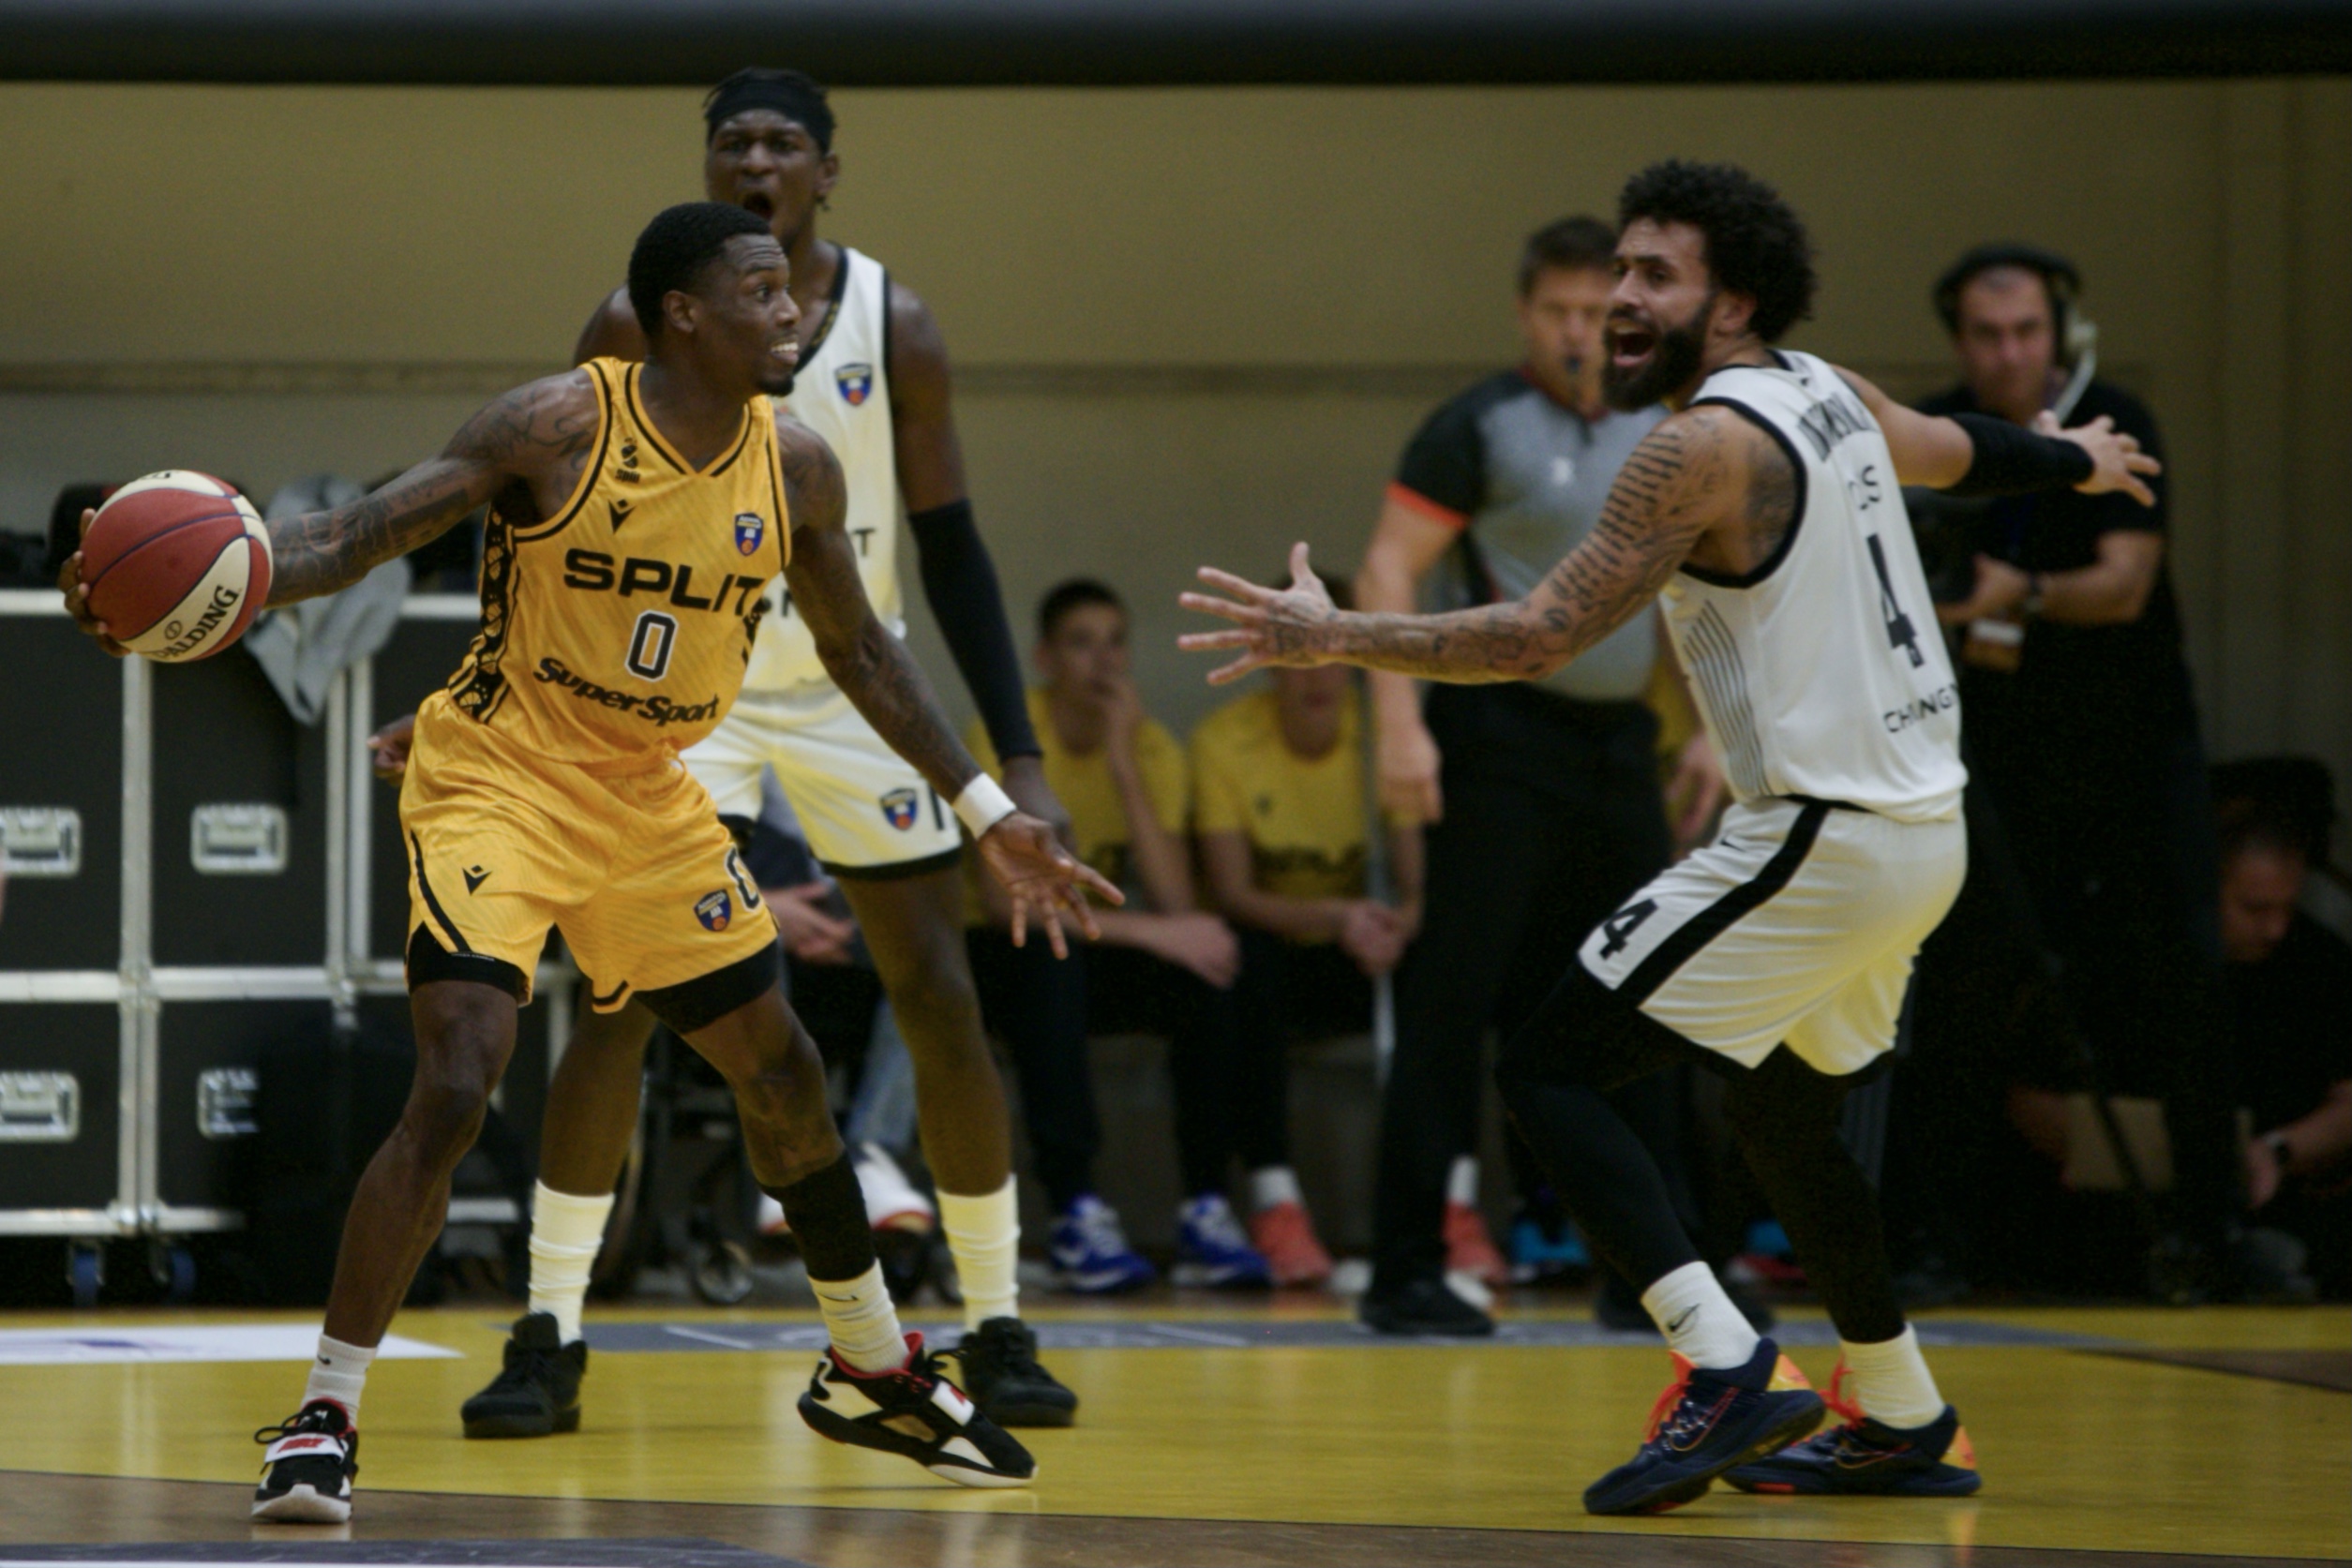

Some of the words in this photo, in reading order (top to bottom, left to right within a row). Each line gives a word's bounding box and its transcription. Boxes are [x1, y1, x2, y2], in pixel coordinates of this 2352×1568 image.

[564, 548, 766, 616] SPLIT
[1866, 533, 1925, 669] 4
[624, 609, 679, 681] 0
[533, 656, 720, 726] SuperSport
[1600, 897, 1659, 961] 4
